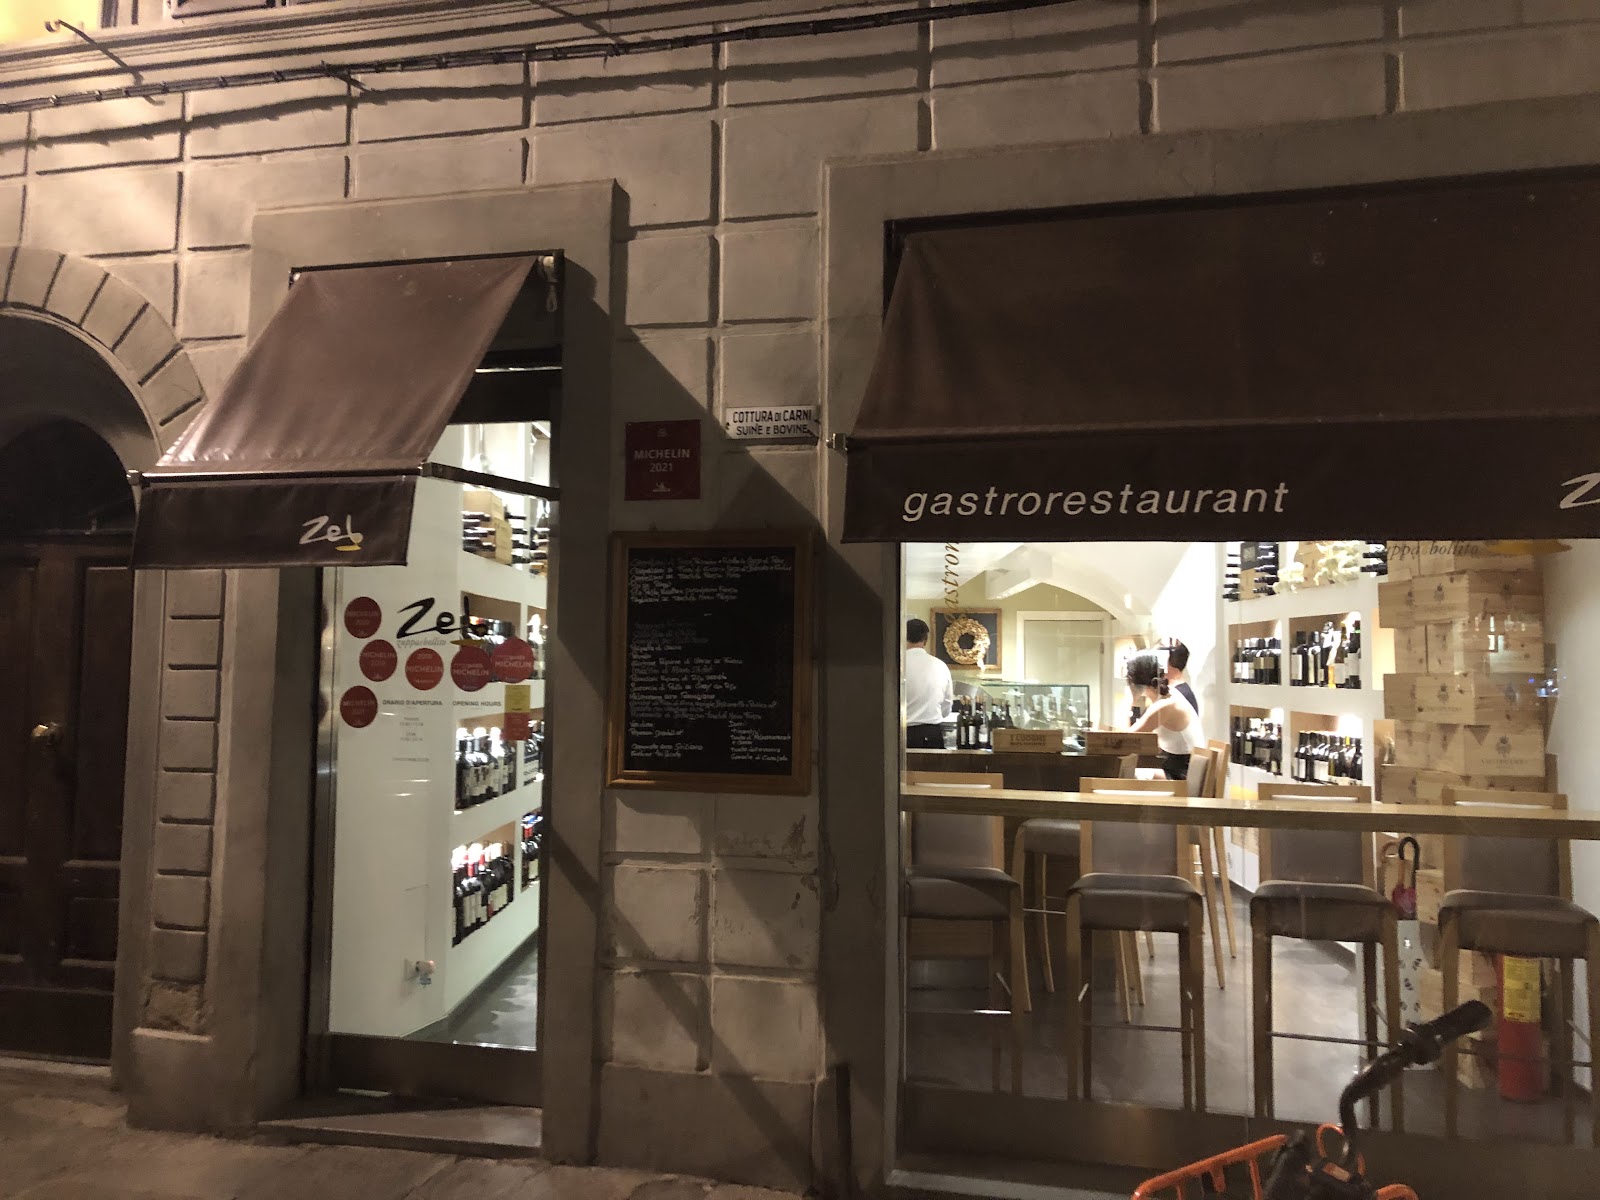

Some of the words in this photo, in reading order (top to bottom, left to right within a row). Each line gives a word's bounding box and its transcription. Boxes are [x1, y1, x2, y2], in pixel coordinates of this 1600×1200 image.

[733, 410, 773, 423] COTTURA
[783, 409, 812, 422] CARNI
[736, 425, 763, 436] SUINE
[773, 424, 809, 435] BOVINE
[634, 448, 691, 461] MICHELIN
[649, 462, 673, 473] 2021
[902, 482, 1289, 522] gastrorestaurant
[362, 651, 396, 659] MICHELIN
[406, 665, 443, 673] MICHELIN
[494, 660, 532, 668] MICHELIN
[452, 668, 489, 676] MICHELIN
